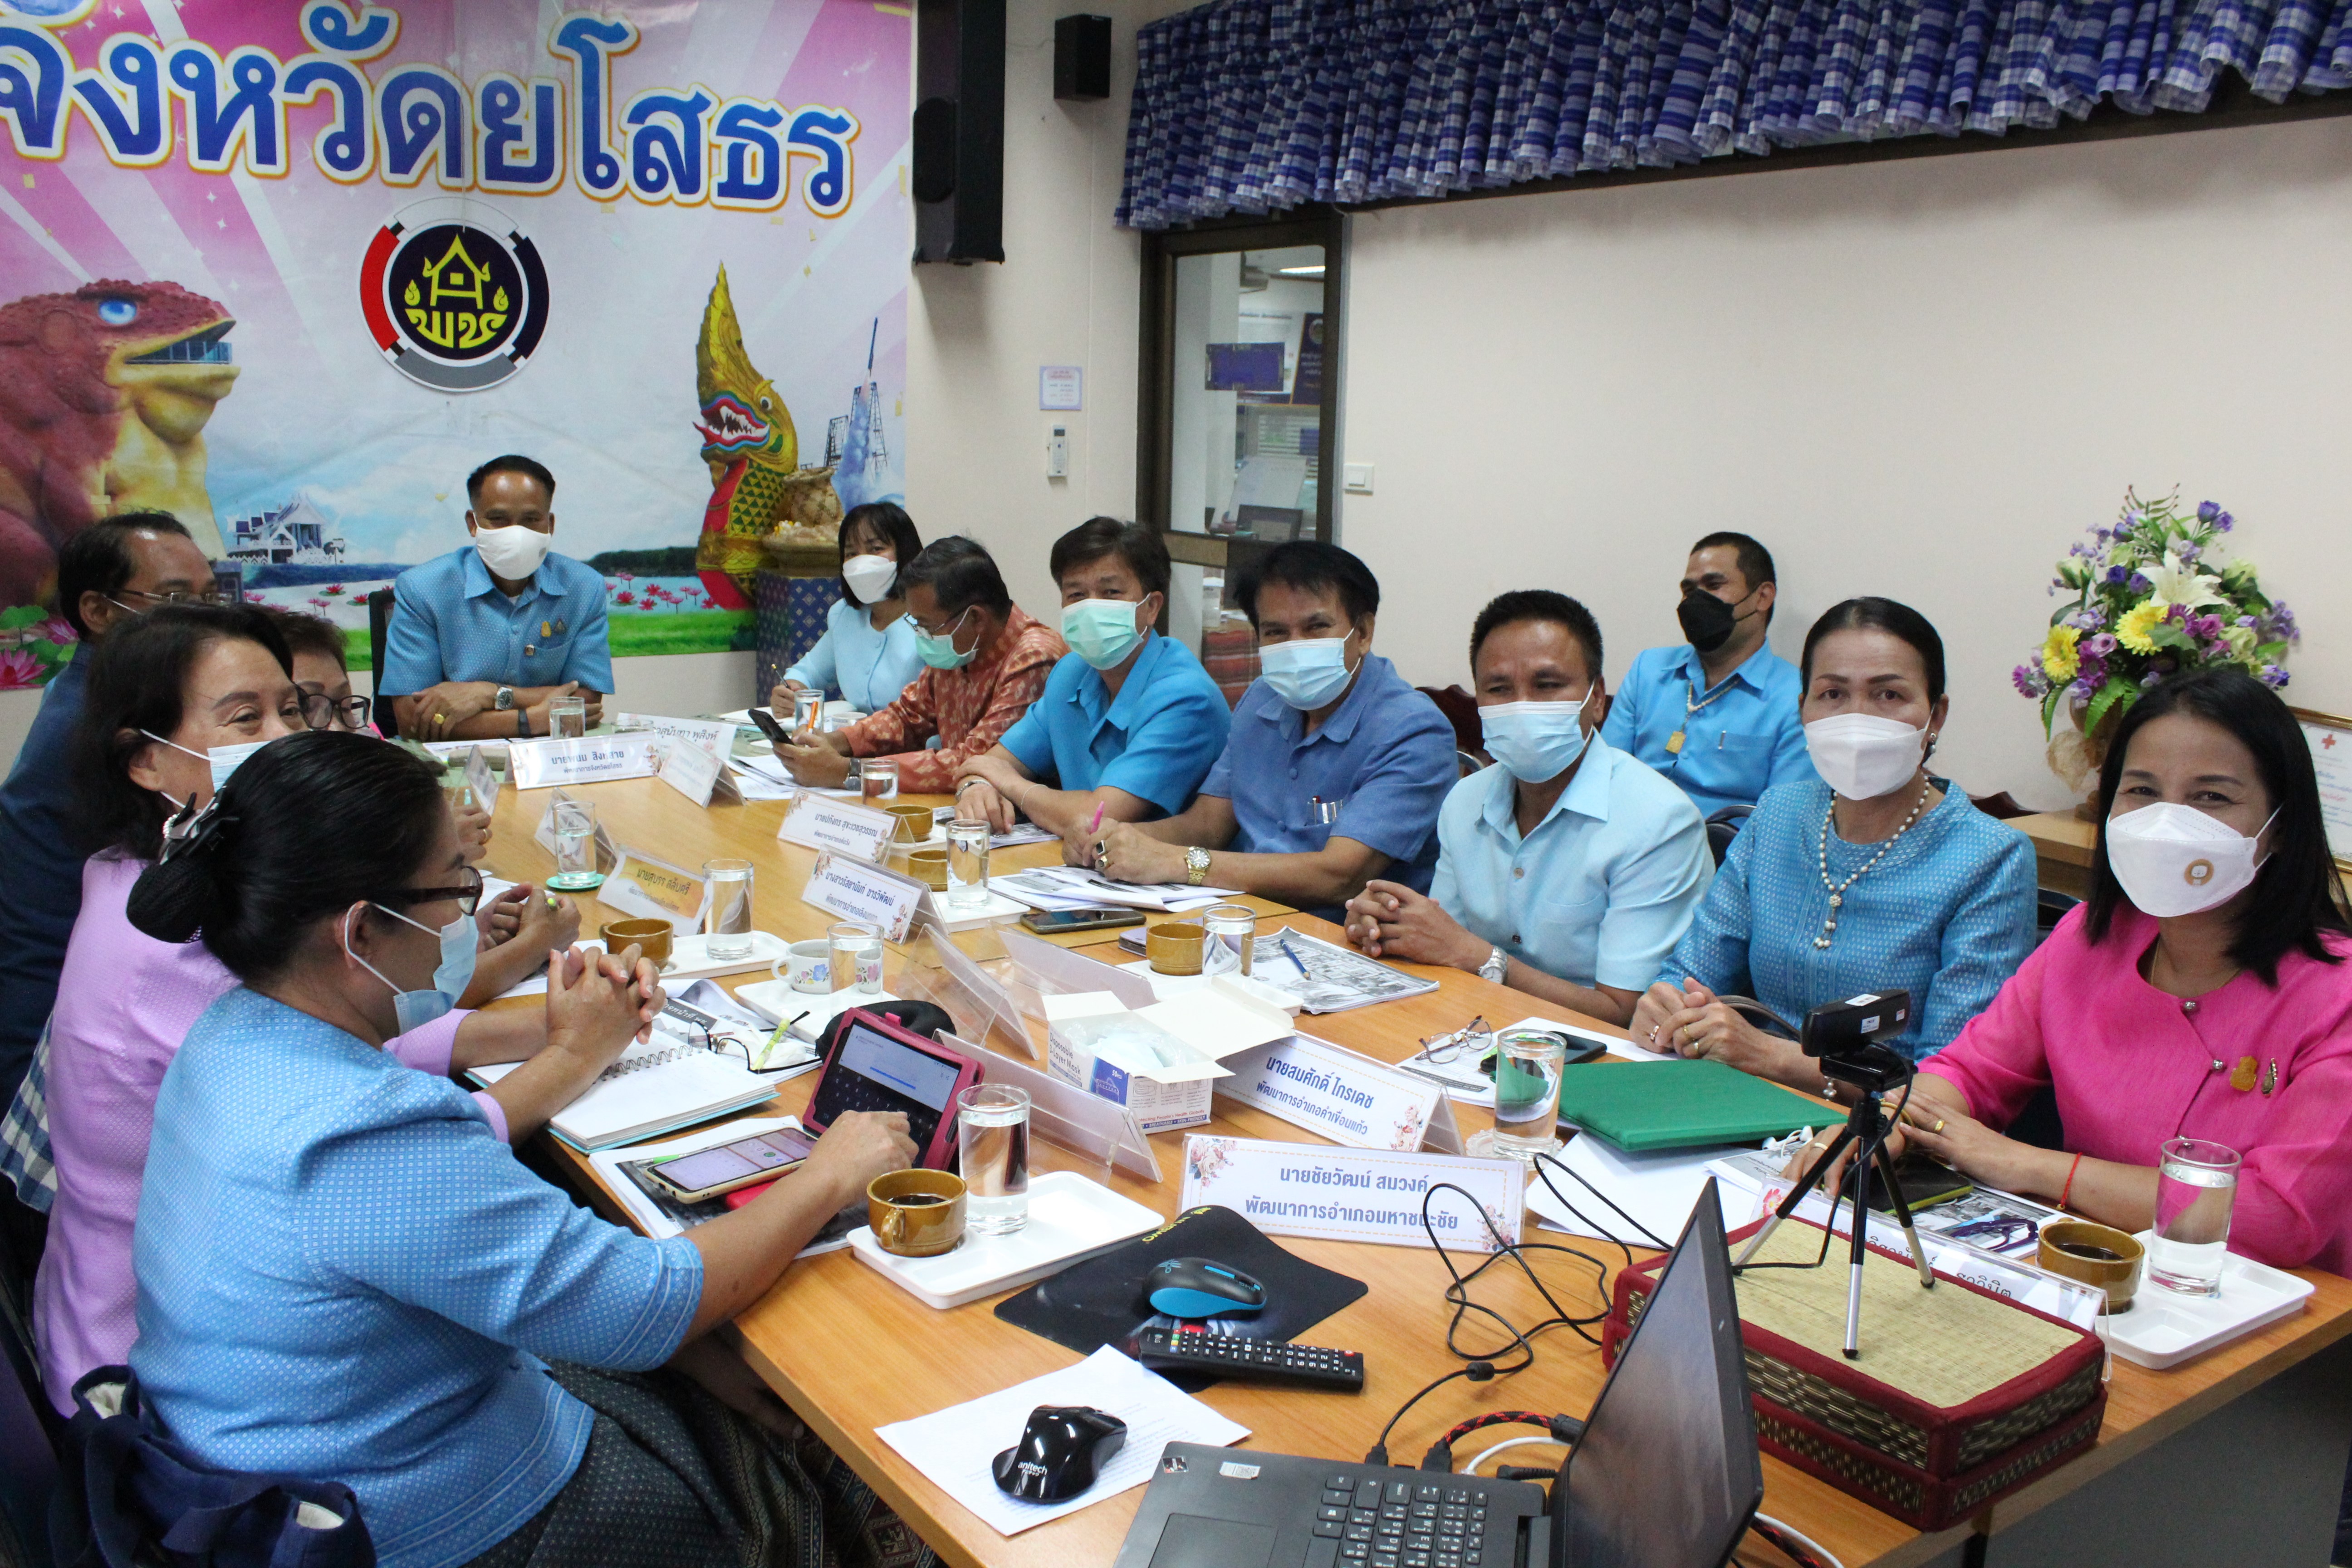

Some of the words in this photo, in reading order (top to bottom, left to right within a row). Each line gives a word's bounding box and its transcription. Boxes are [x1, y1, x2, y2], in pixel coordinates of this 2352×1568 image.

[1049, 1044, 1066, 1064] 3-Layer
[1067, 1058, 1081, 1076] Mask
[1050, 1032, 1073, 1058] Disposable
[1265, 1056, 1335, 1092] นายสมศักดิ์
[1331, 1077, 1375, 1109] ไกรเดช
[1256, 1080, 1368, 1135] พัฒนาการอำเภอคำเขื่อนแก้ว
[1280, 1166, 1372, 1189] นายชัยวัฒน์
[1376, 1169, 1430, 1193] สมวงค์
[1245, 1195, 1458, 1229] พัฒนาการอำเภอมหาชนะชัย
[1018, 1461, 1048, 1475] anitech
